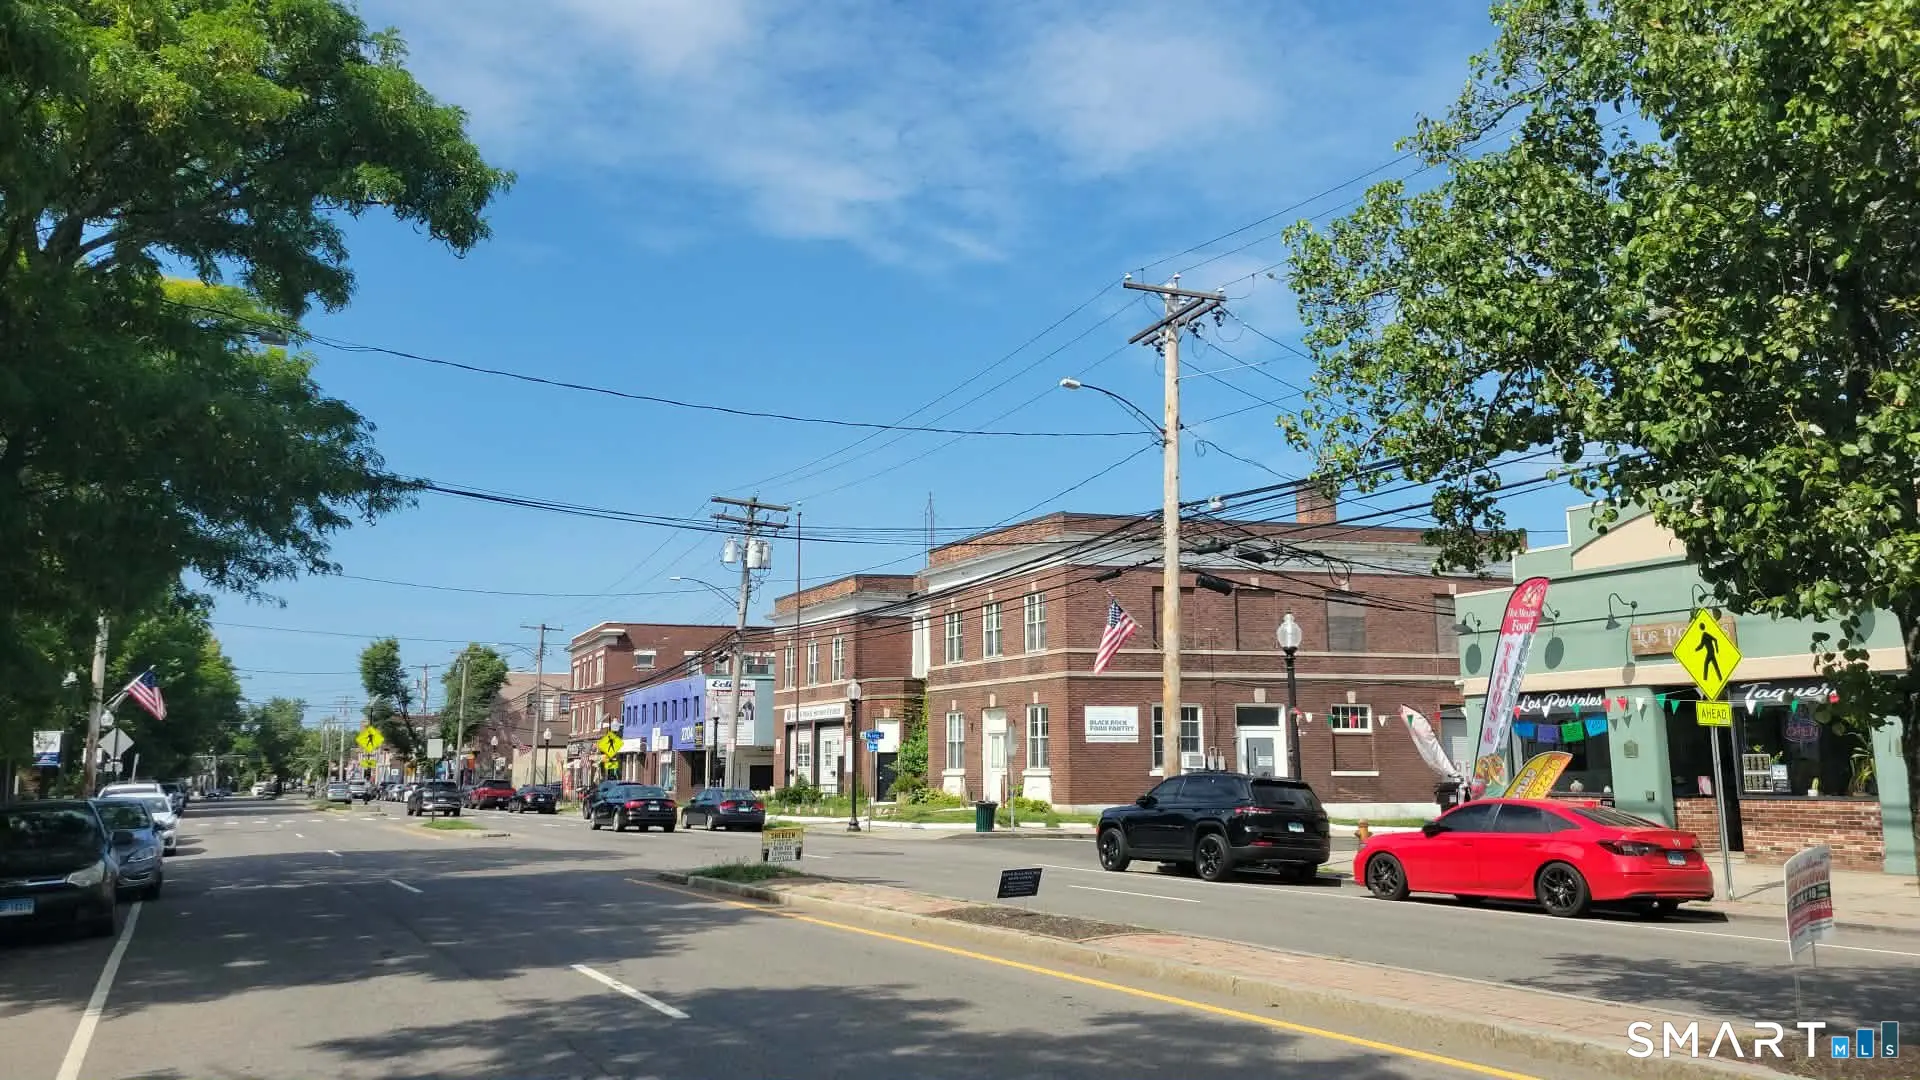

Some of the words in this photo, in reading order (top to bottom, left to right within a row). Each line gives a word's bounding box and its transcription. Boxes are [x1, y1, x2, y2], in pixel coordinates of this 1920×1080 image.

[1511, 619, 1534, 632] Food
[1740, 682, 1837, 702] Taquer
[1520, 695, 1541, 712] Los
[1701, 708, 1728, 719] AHEAD
